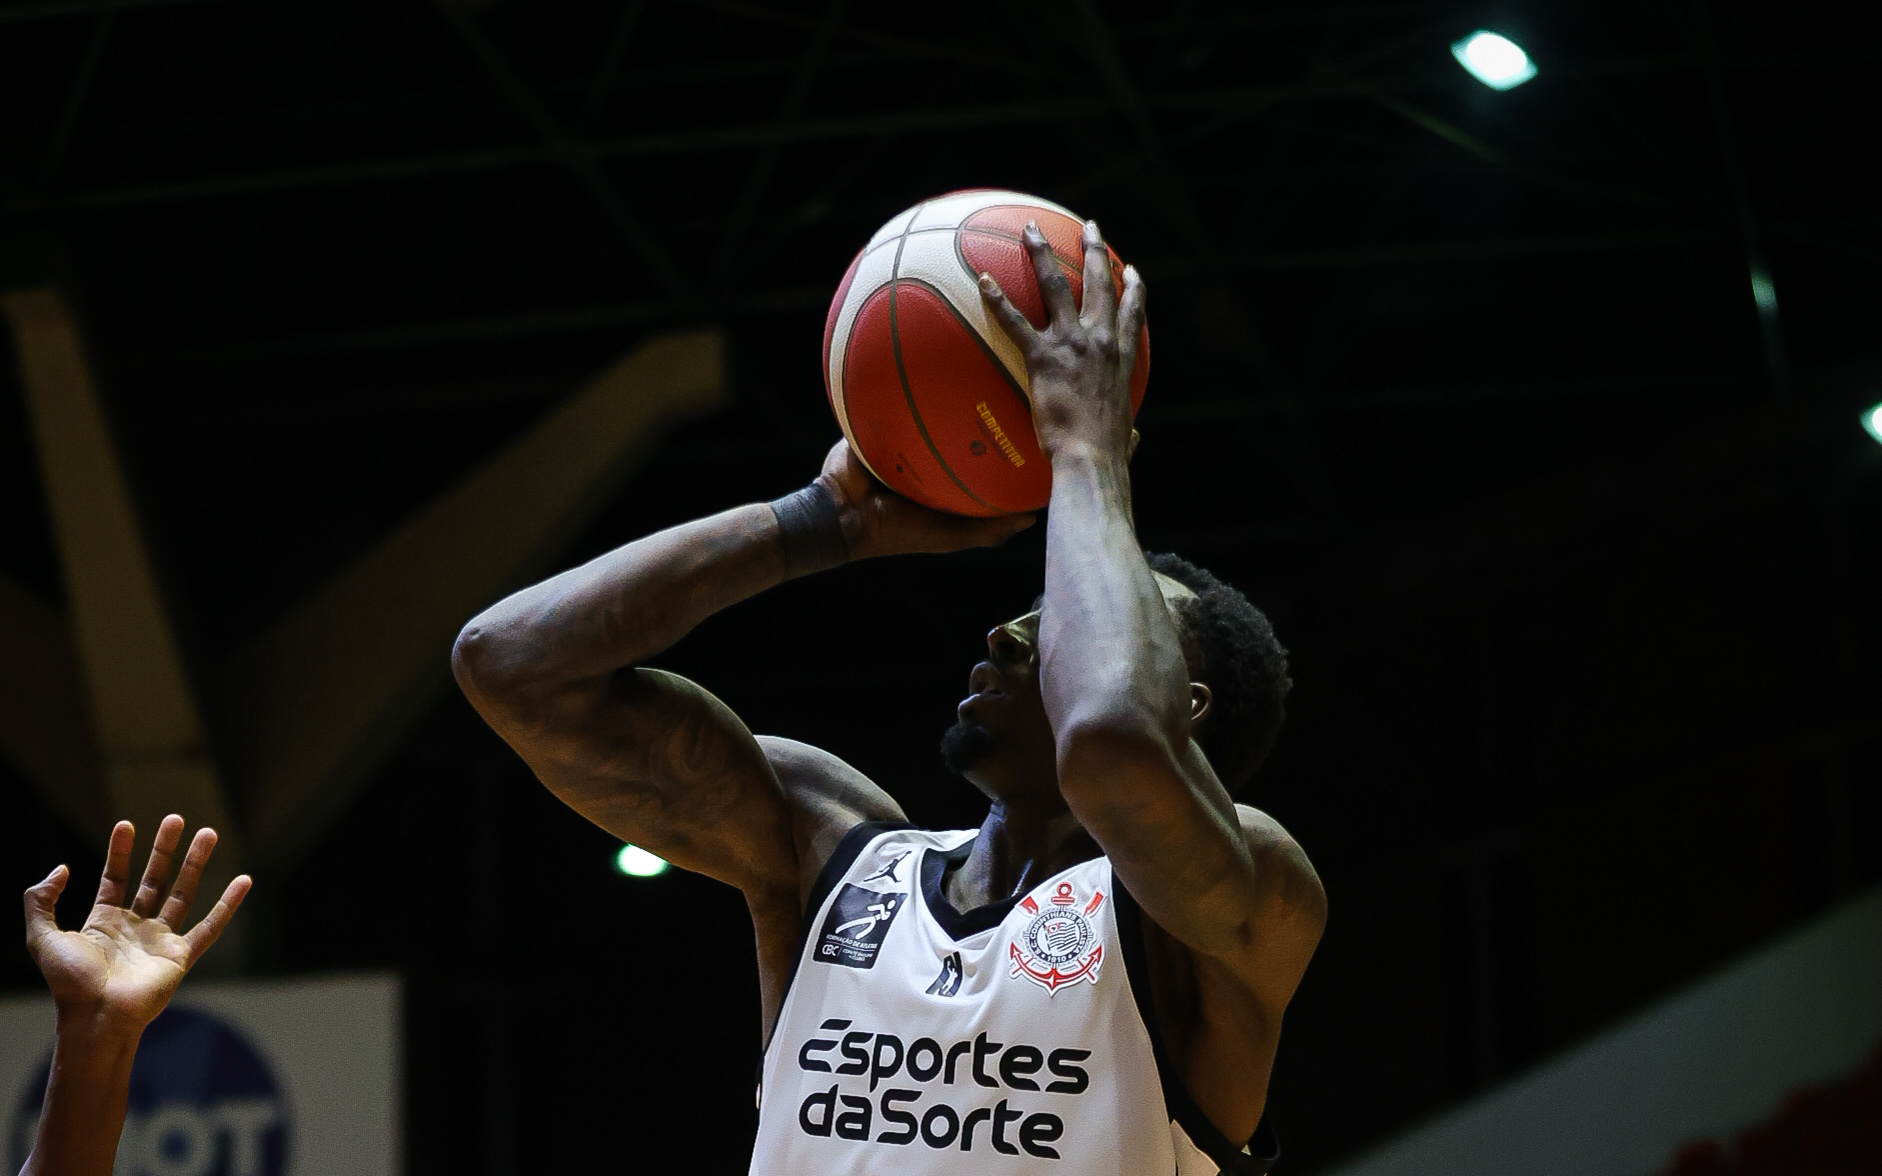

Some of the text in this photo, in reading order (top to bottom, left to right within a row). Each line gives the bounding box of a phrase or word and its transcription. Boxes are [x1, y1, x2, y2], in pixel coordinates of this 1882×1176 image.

[1030, 911, 1077, 939] CORINTHIANS
[1073, 918, 1086, 954] PAULISTA
[798, 1018, 1092, 1095] Esportes
